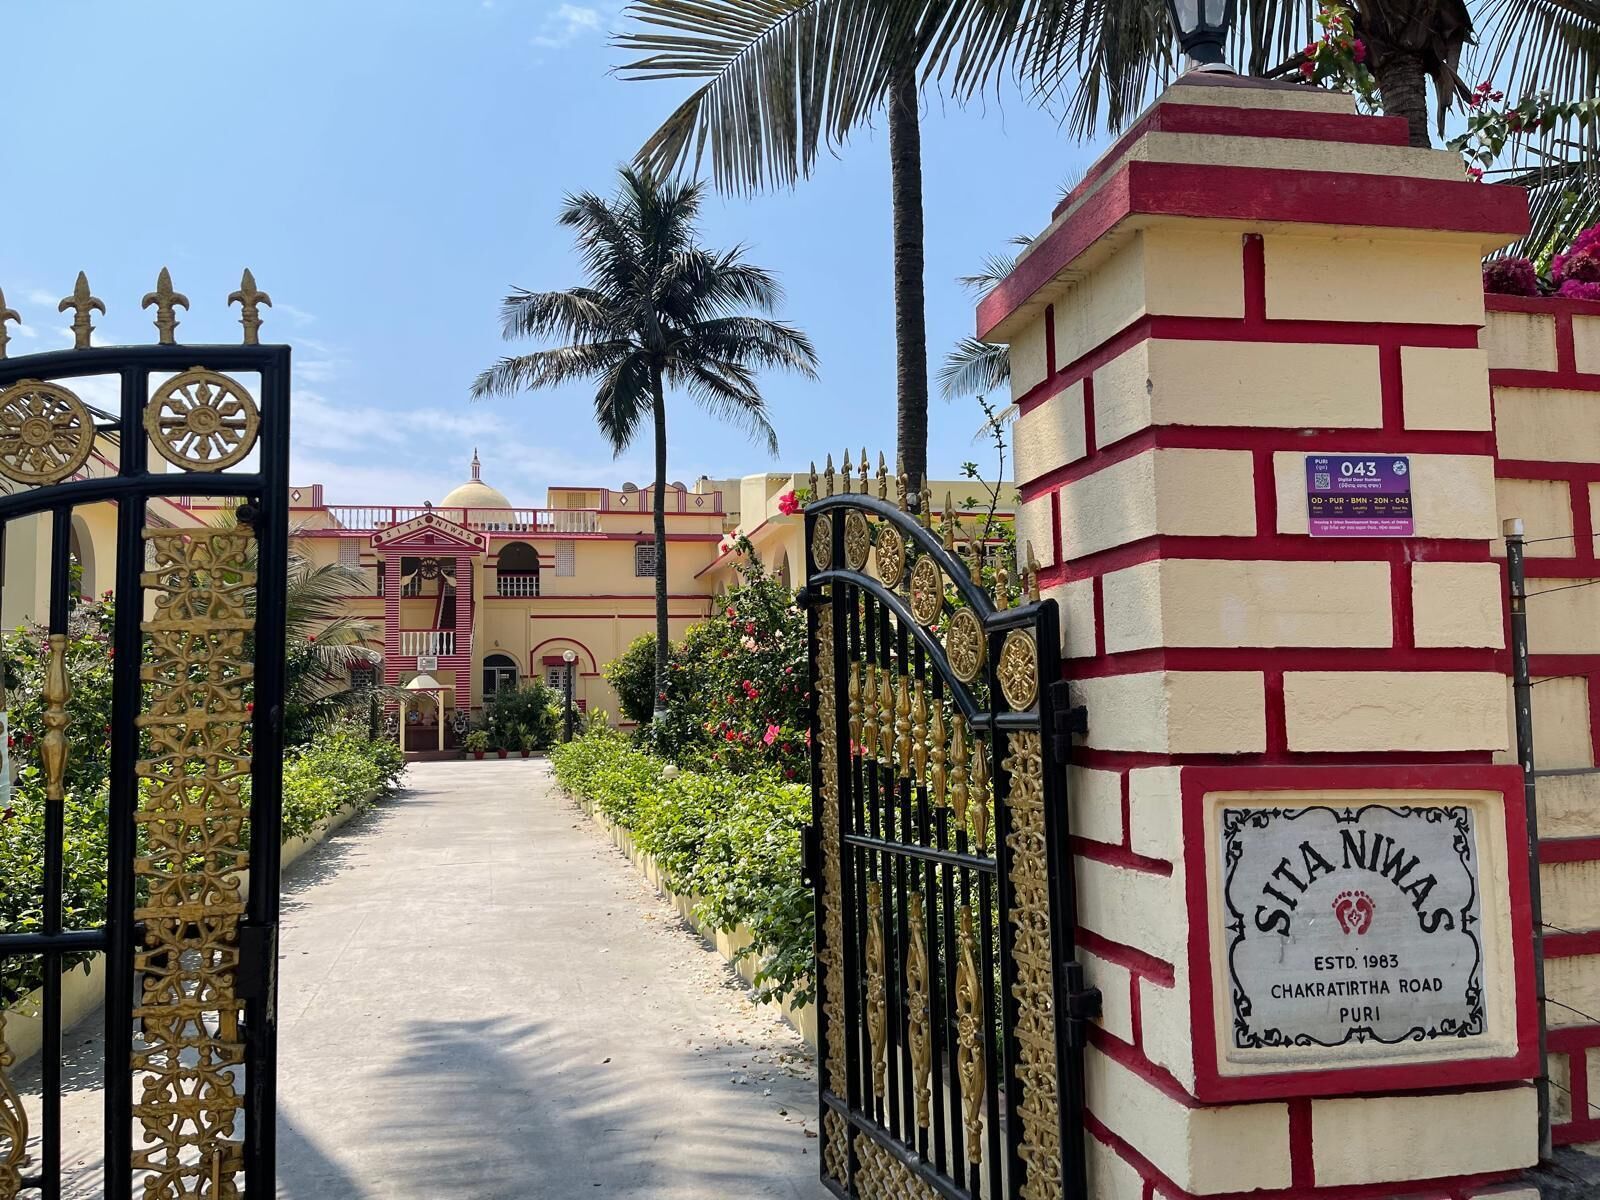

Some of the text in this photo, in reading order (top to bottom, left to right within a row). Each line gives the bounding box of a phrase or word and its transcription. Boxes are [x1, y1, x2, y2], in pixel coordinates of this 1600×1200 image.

[1341, 461, 1377, 476] 043
[386, 520, 472, 540] SITA NIWAS
[1254, 829, 1455, 936] SITA NIWAS
[1314, 954, 1399, 970] ESTD. 1983
[1271, 978, 1443, 999] CHAKRATIRTHA ROAD
[1339, 1007, 1380, 1023] PURI
